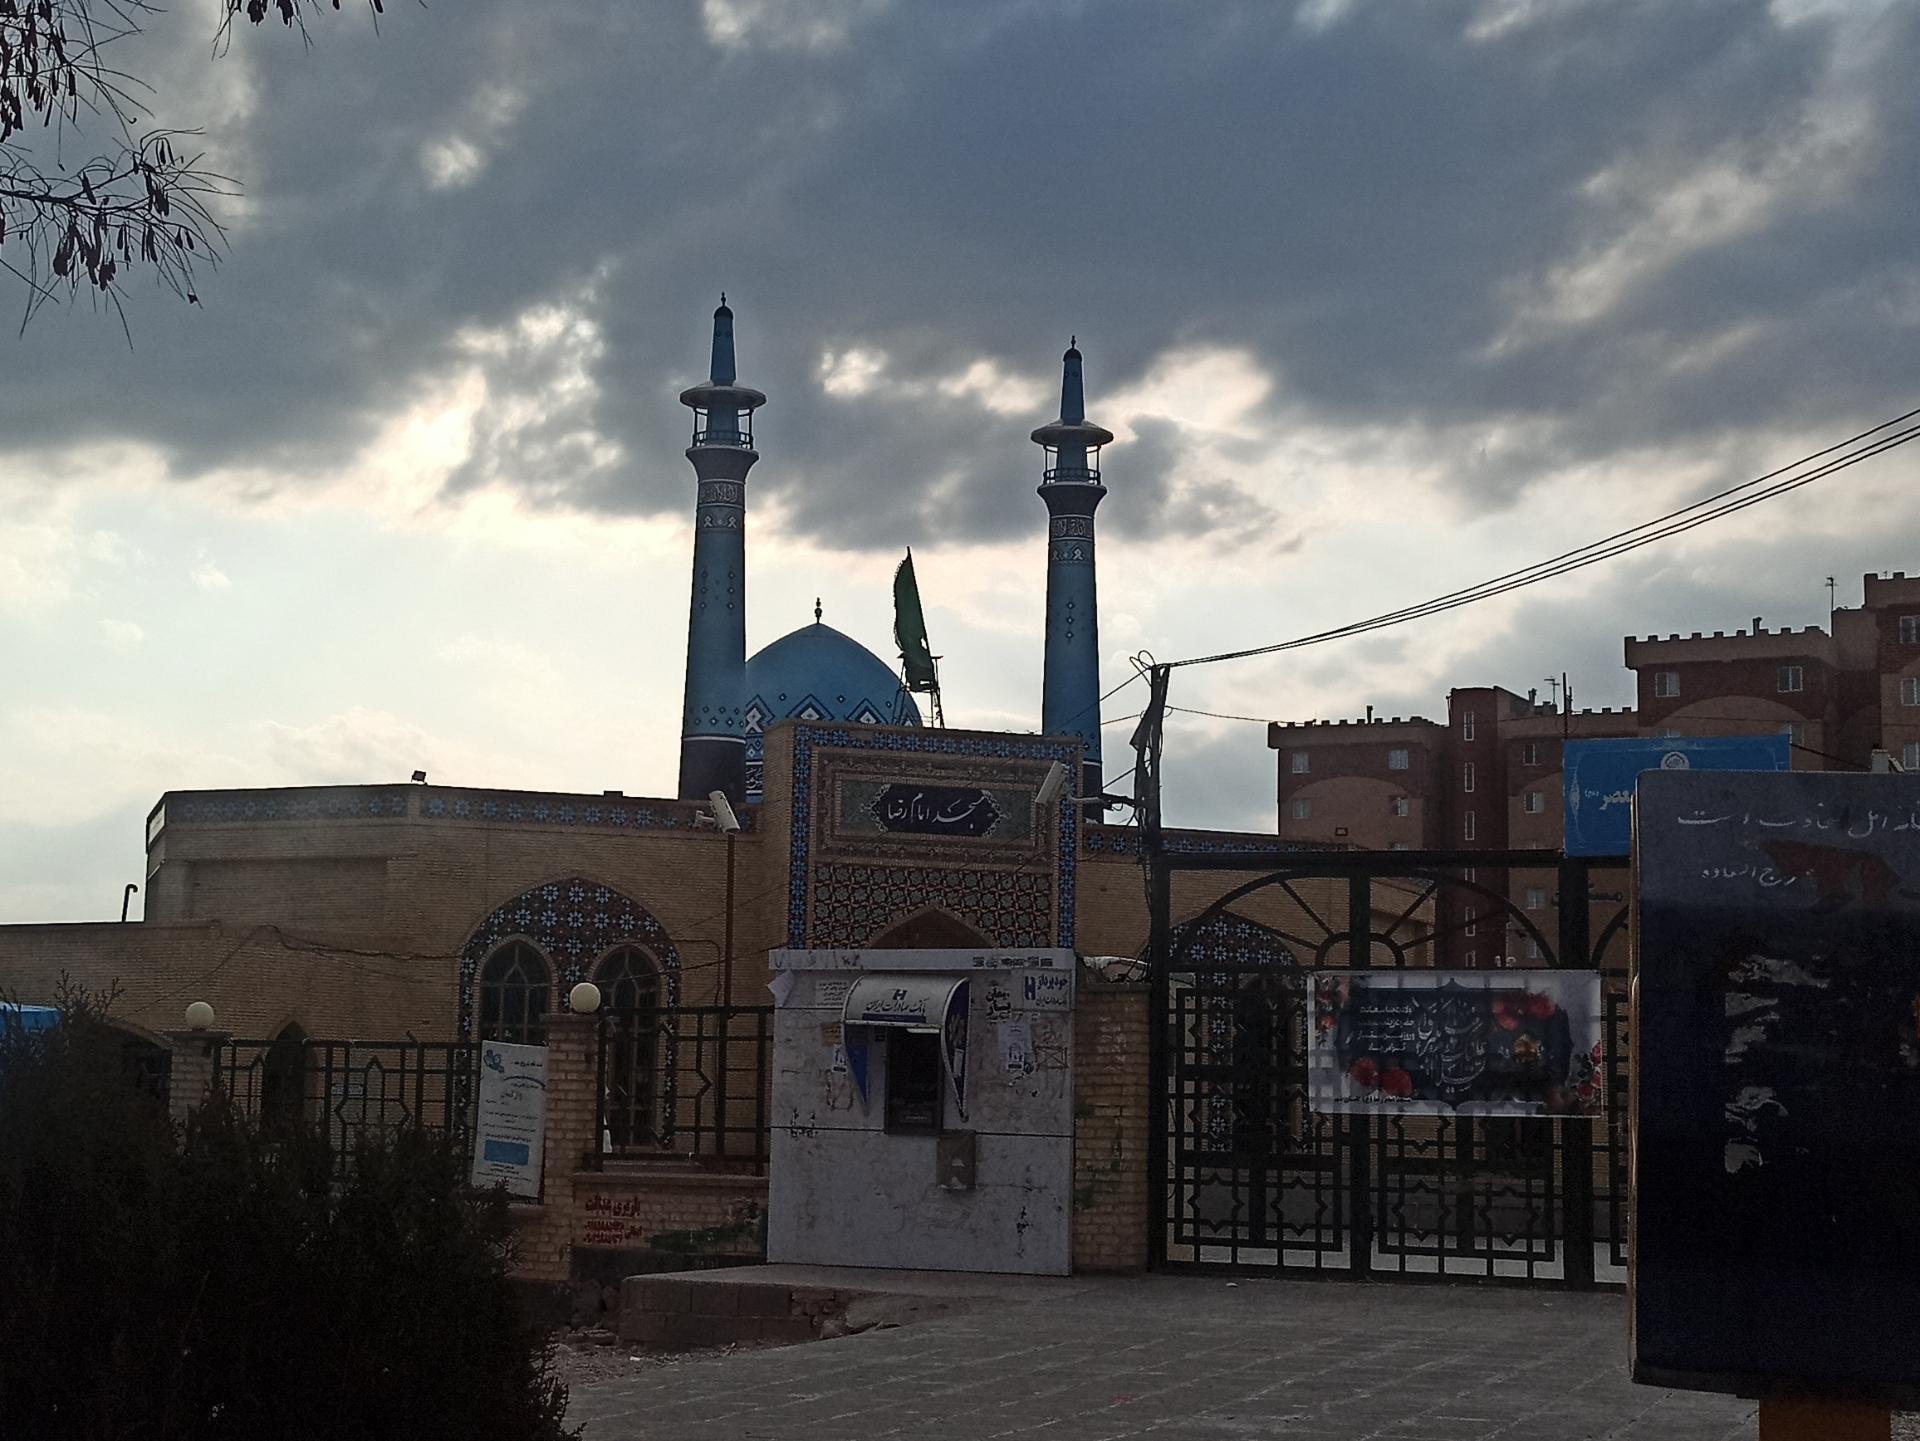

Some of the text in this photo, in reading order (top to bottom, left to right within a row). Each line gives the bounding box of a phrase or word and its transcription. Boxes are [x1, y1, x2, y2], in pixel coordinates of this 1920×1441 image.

[887, 791, 987, 829] مسجد امام رضا
[865, 997, 928, 1013] بانک صادرات ایران
